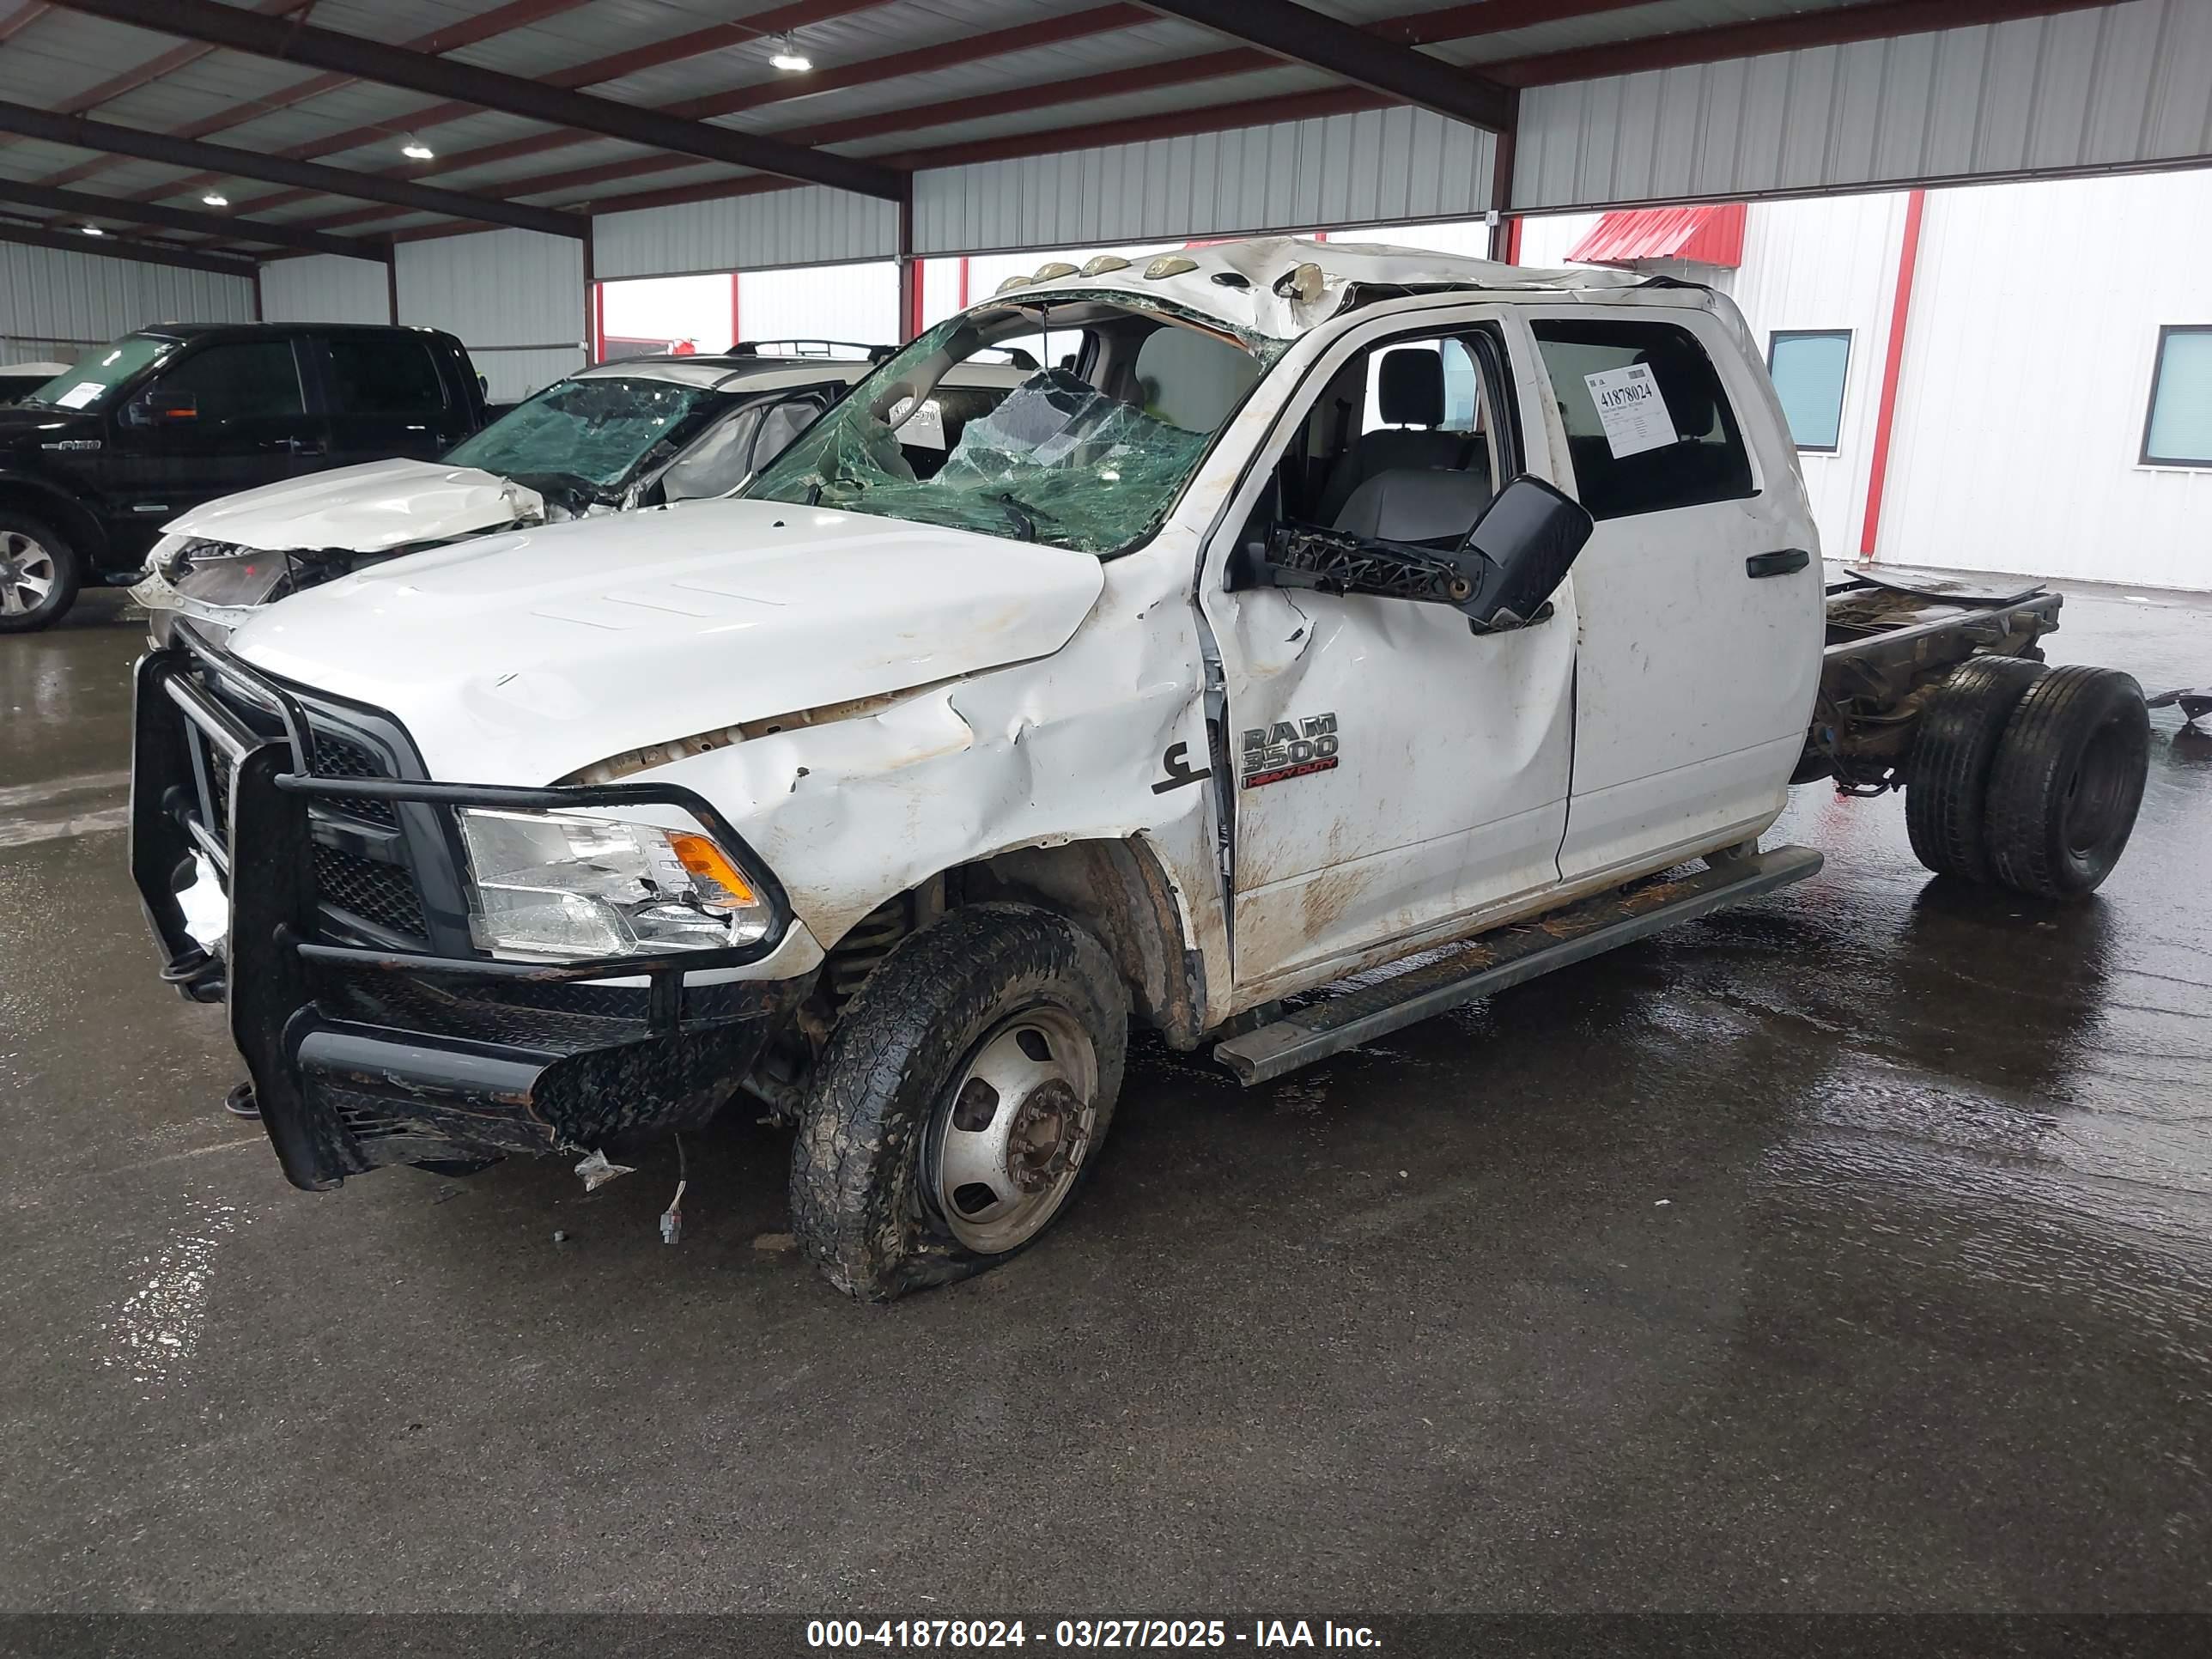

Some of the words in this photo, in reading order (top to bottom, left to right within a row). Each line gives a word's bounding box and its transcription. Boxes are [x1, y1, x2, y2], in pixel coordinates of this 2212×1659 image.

[1600, 383, 1653, 408] 41878024
[1243, 712, 1338, 752] RAM
[1243, 734, 1339, 775] 3500
[1299, 758, 1336, 774] DUTY
